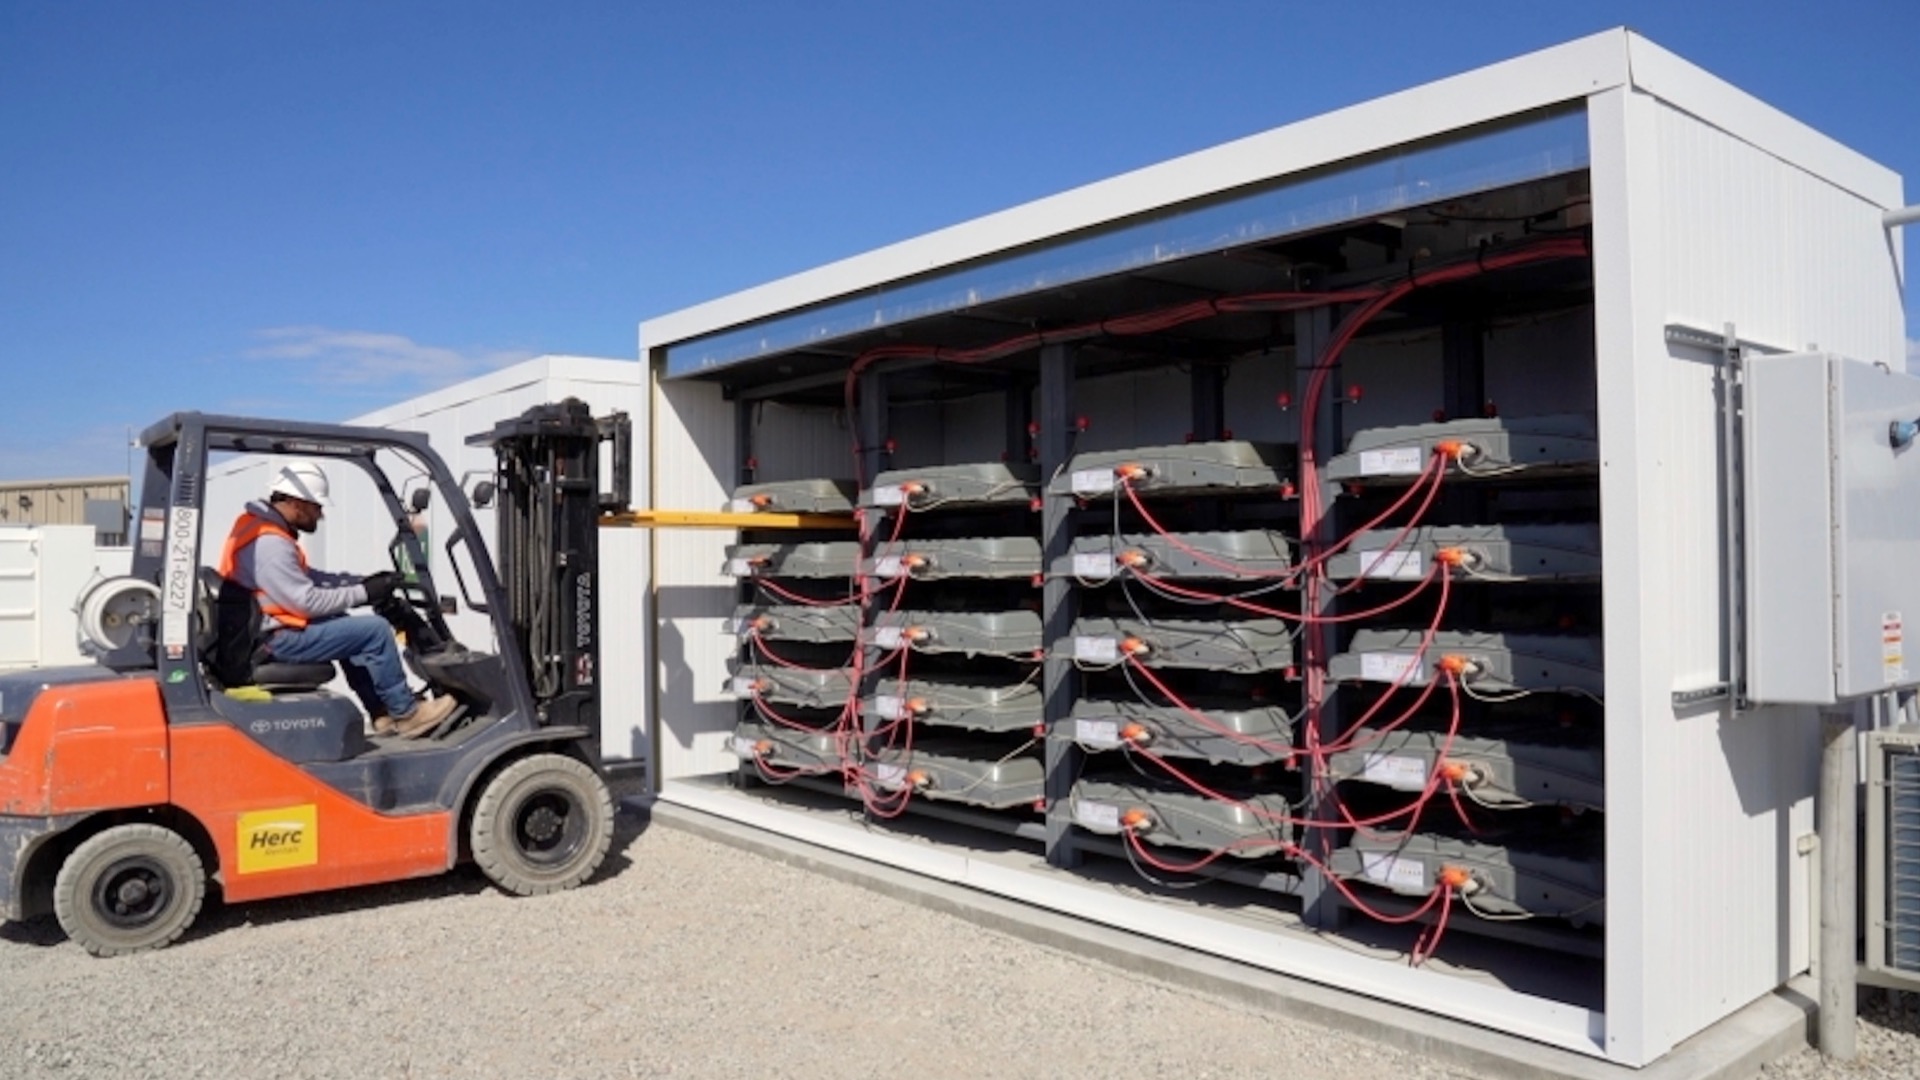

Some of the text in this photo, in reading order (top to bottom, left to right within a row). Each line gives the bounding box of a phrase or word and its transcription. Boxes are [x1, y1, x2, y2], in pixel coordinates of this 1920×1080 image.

[170, 508, 193, 610] 800-21-6227
[576, 572, 591, 648] TOYOTA
[273, 717, 325, 731] TOYOTA
[250, 829, 303, 850] Herc
